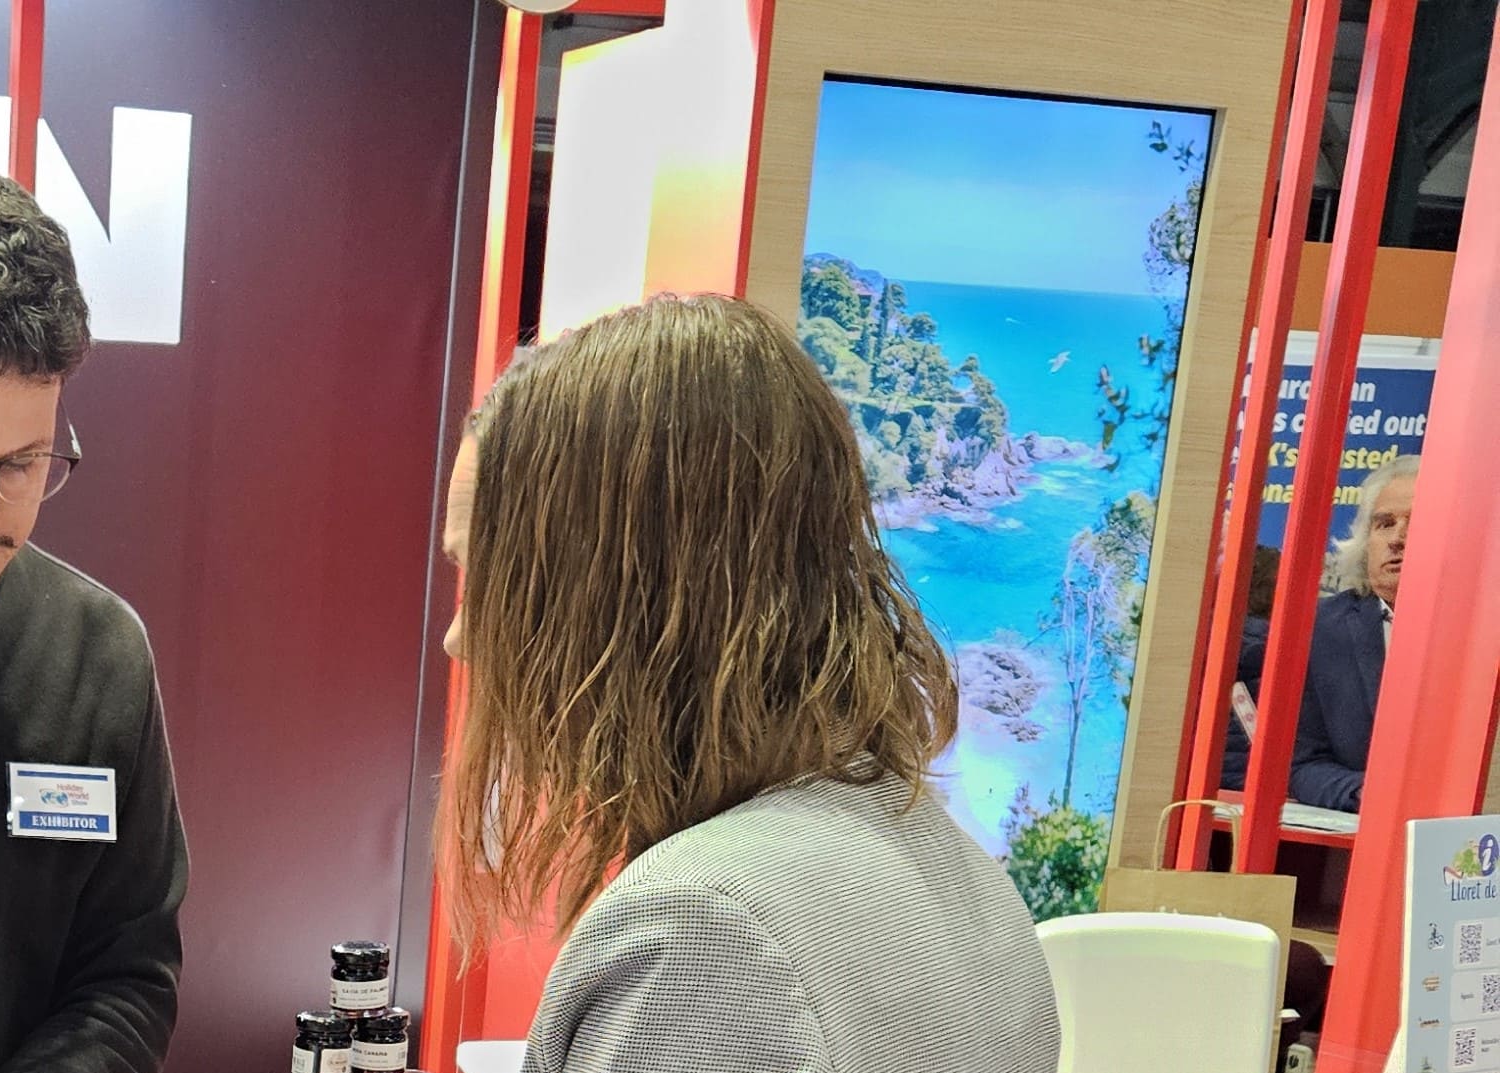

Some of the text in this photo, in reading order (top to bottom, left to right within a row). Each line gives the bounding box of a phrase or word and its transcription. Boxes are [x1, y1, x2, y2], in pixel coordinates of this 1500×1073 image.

[1384, 414, 1426, 436] out
[32, 815, 98, 829] EXHIBITOR
[1451, 879, 1496, 901] Lloret de
